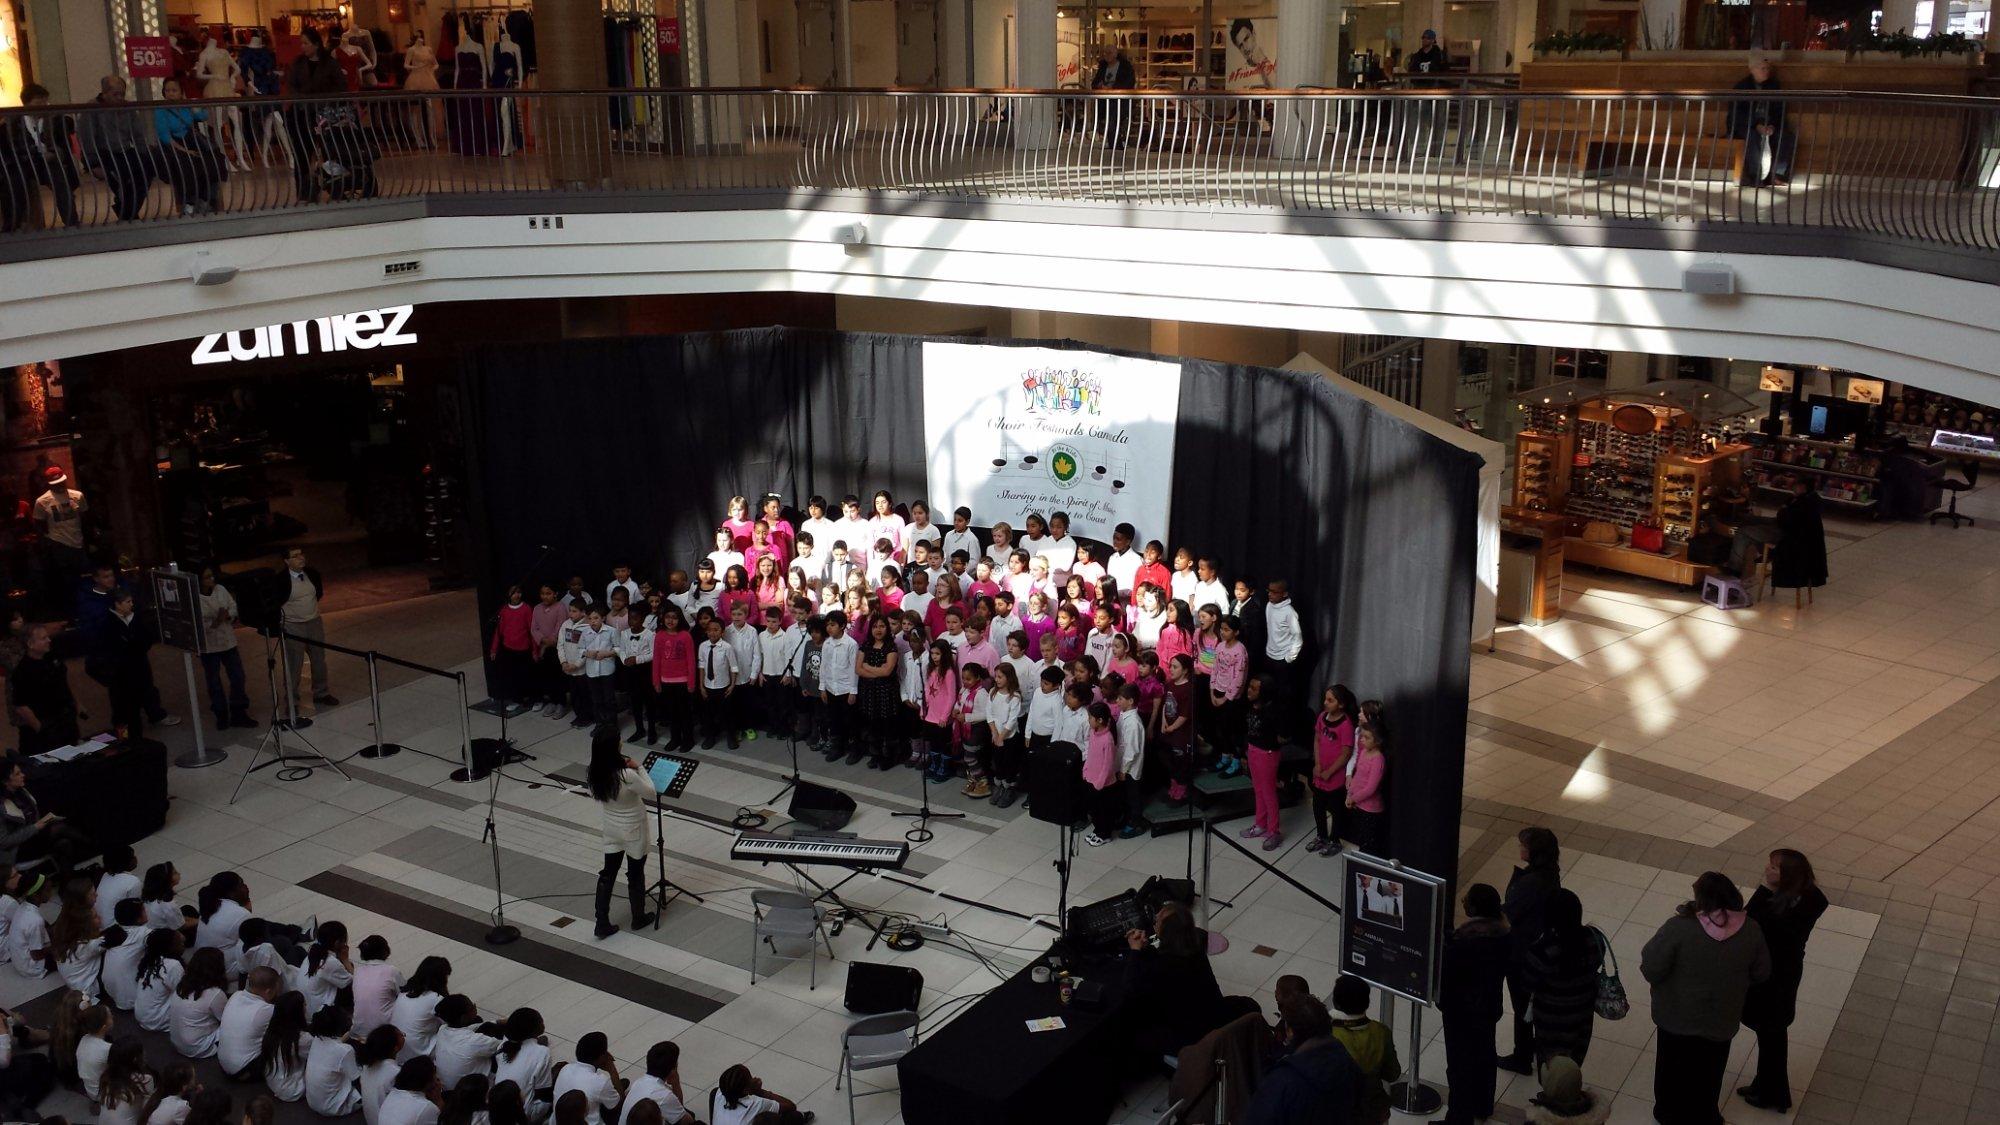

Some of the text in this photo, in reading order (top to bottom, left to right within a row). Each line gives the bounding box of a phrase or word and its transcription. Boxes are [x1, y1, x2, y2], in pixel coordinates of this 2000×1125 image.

[191, 304, 418, 365] zumiez
[986, 416, 1025, 430] Choir
[1088, 425, 1129, 445] Canada
[996, 489, 1037, 503] Sharing
[1039, 493, 1048, 502] in
[1049, 493, 1061, 505] the
[1062, 496, 1089, 509] Spirit
[1089, 500, 1101, 512] of
[1016, 503, 1045, 516] from
[1074, 512, 1083, 520] to
[1086, 512, 1107, 524] Coast
